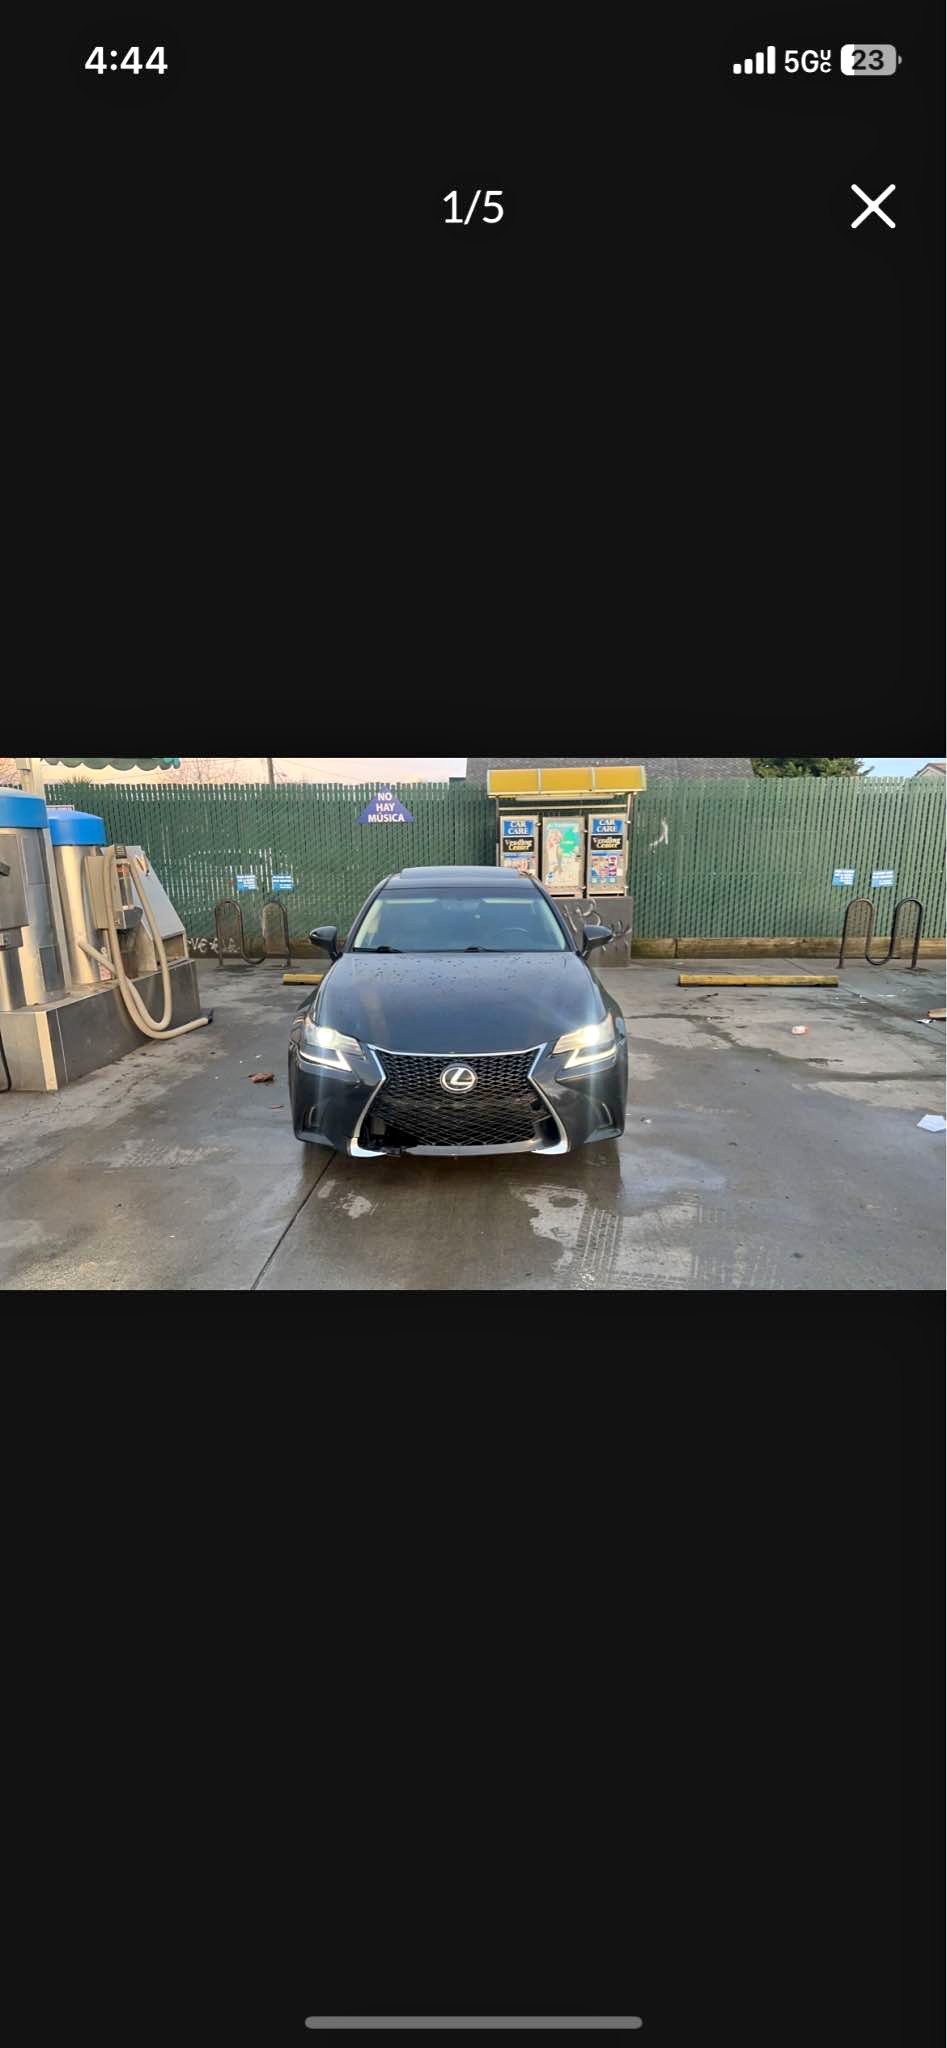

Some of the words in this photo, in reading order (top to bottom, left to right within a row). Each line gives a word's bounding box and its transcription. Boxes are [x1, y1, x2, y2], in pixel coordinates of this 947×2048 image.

[377, 792, 392, 801] NO
[376, 803, 395, 812] HAY
[367, 812, 405, 823] MÚSICA
[597, 825, 617, 833] CARE
[504, 838, 533, 846] Vending
[593, 837, 621, 845] Vending
